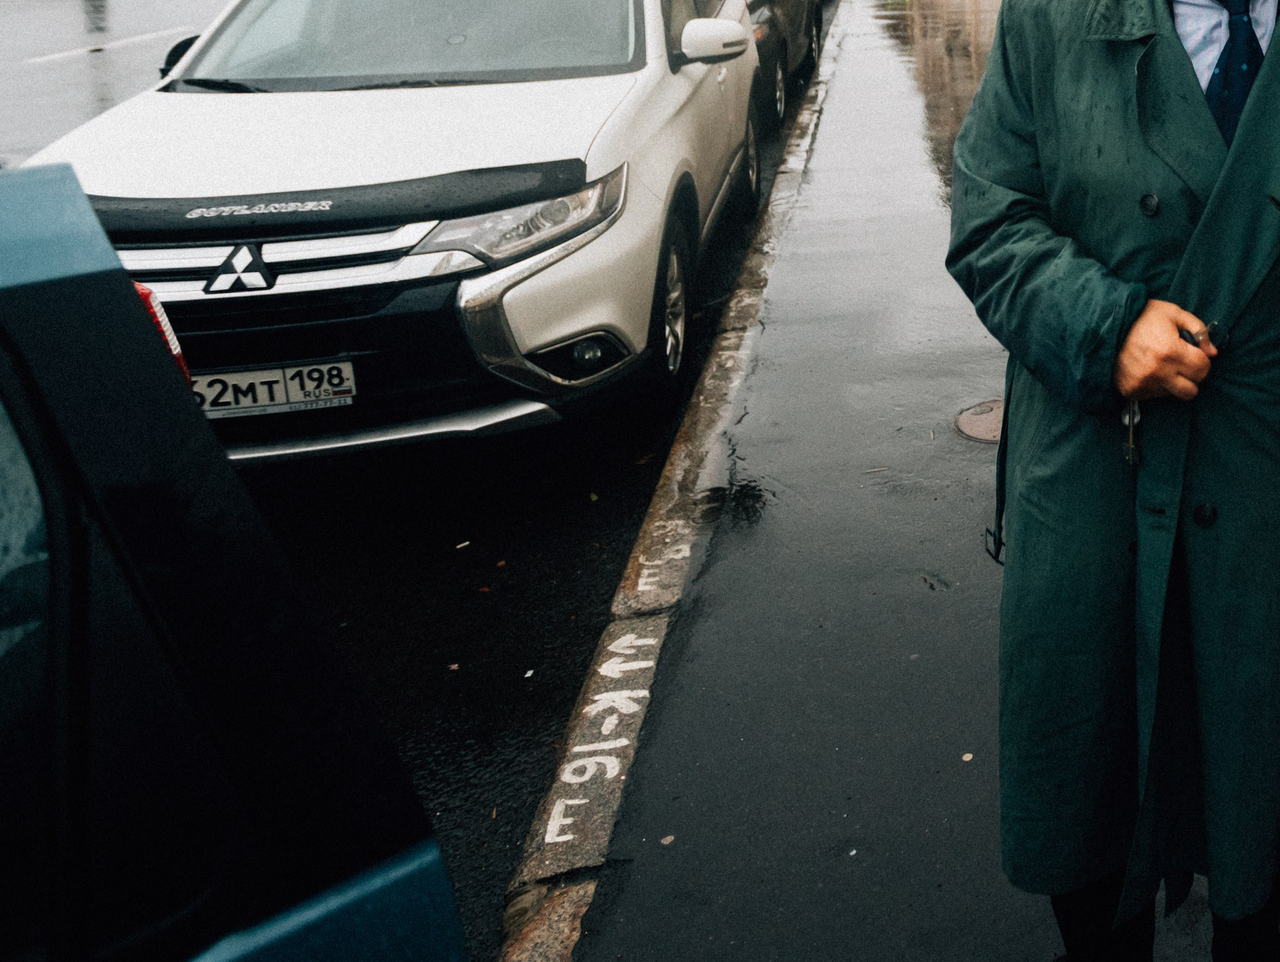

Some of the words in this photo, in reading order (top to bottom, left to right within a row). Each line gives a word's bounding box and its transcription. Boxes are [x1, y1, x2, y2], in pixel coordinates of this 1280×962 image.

[185, 200, 333, 219] OUTLANDER
[289, 366, 346, 391] 198
[303, 388, 332, 399] RUS
